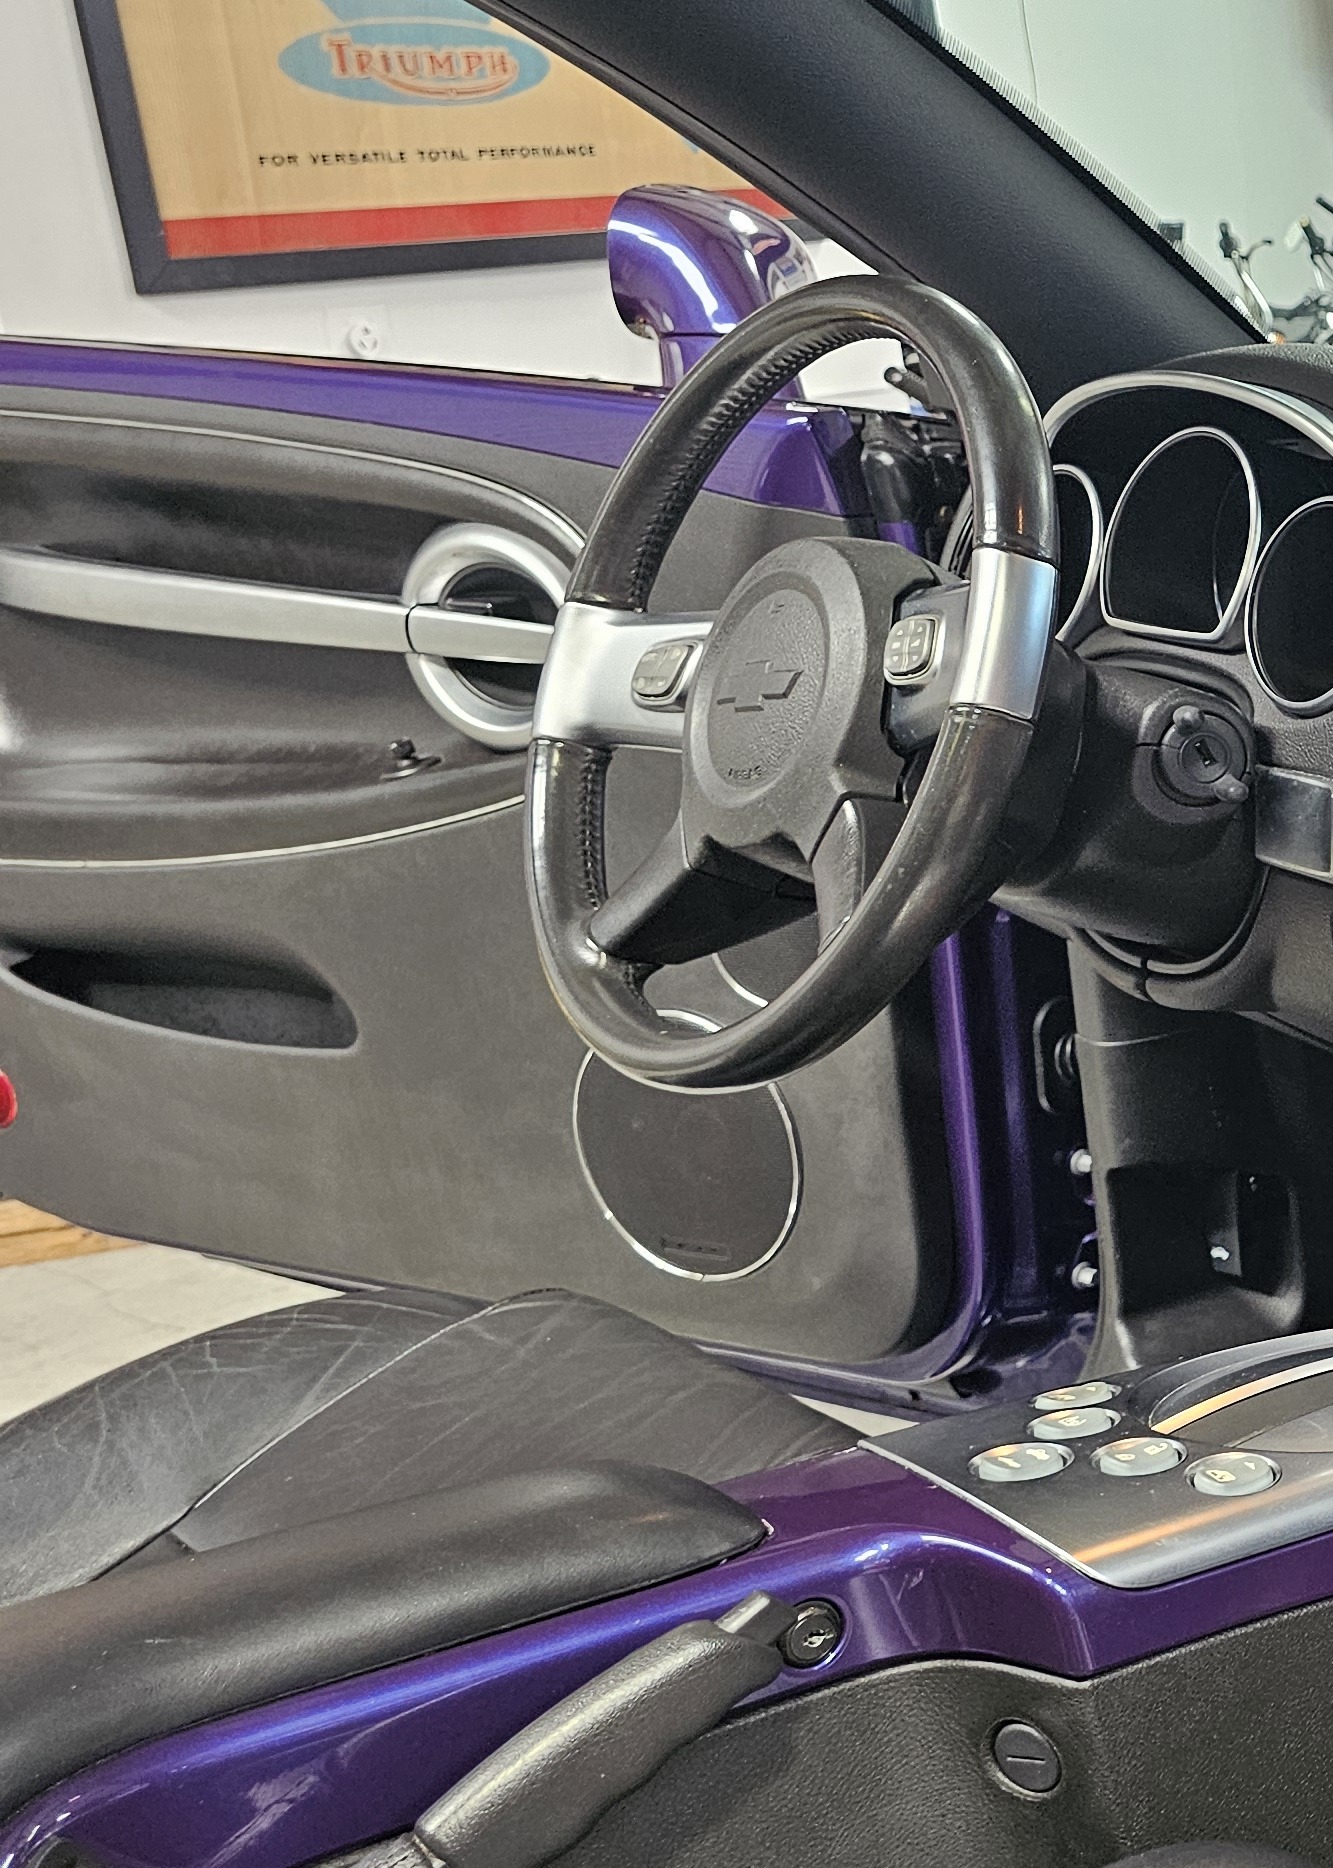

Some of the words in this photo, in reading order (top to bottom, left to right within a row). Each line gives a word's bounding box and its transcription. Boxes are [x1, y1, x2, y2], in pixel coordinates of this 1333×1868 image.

[323, 35, 518, 93] TRIUMPH
[258, 154, 299, 167] FOR
[310, 150, 407, 167] VERSATILE
[417, 147, 470, 163] TOTAL
[478, 144, 598, 161] PERFORMANCE
